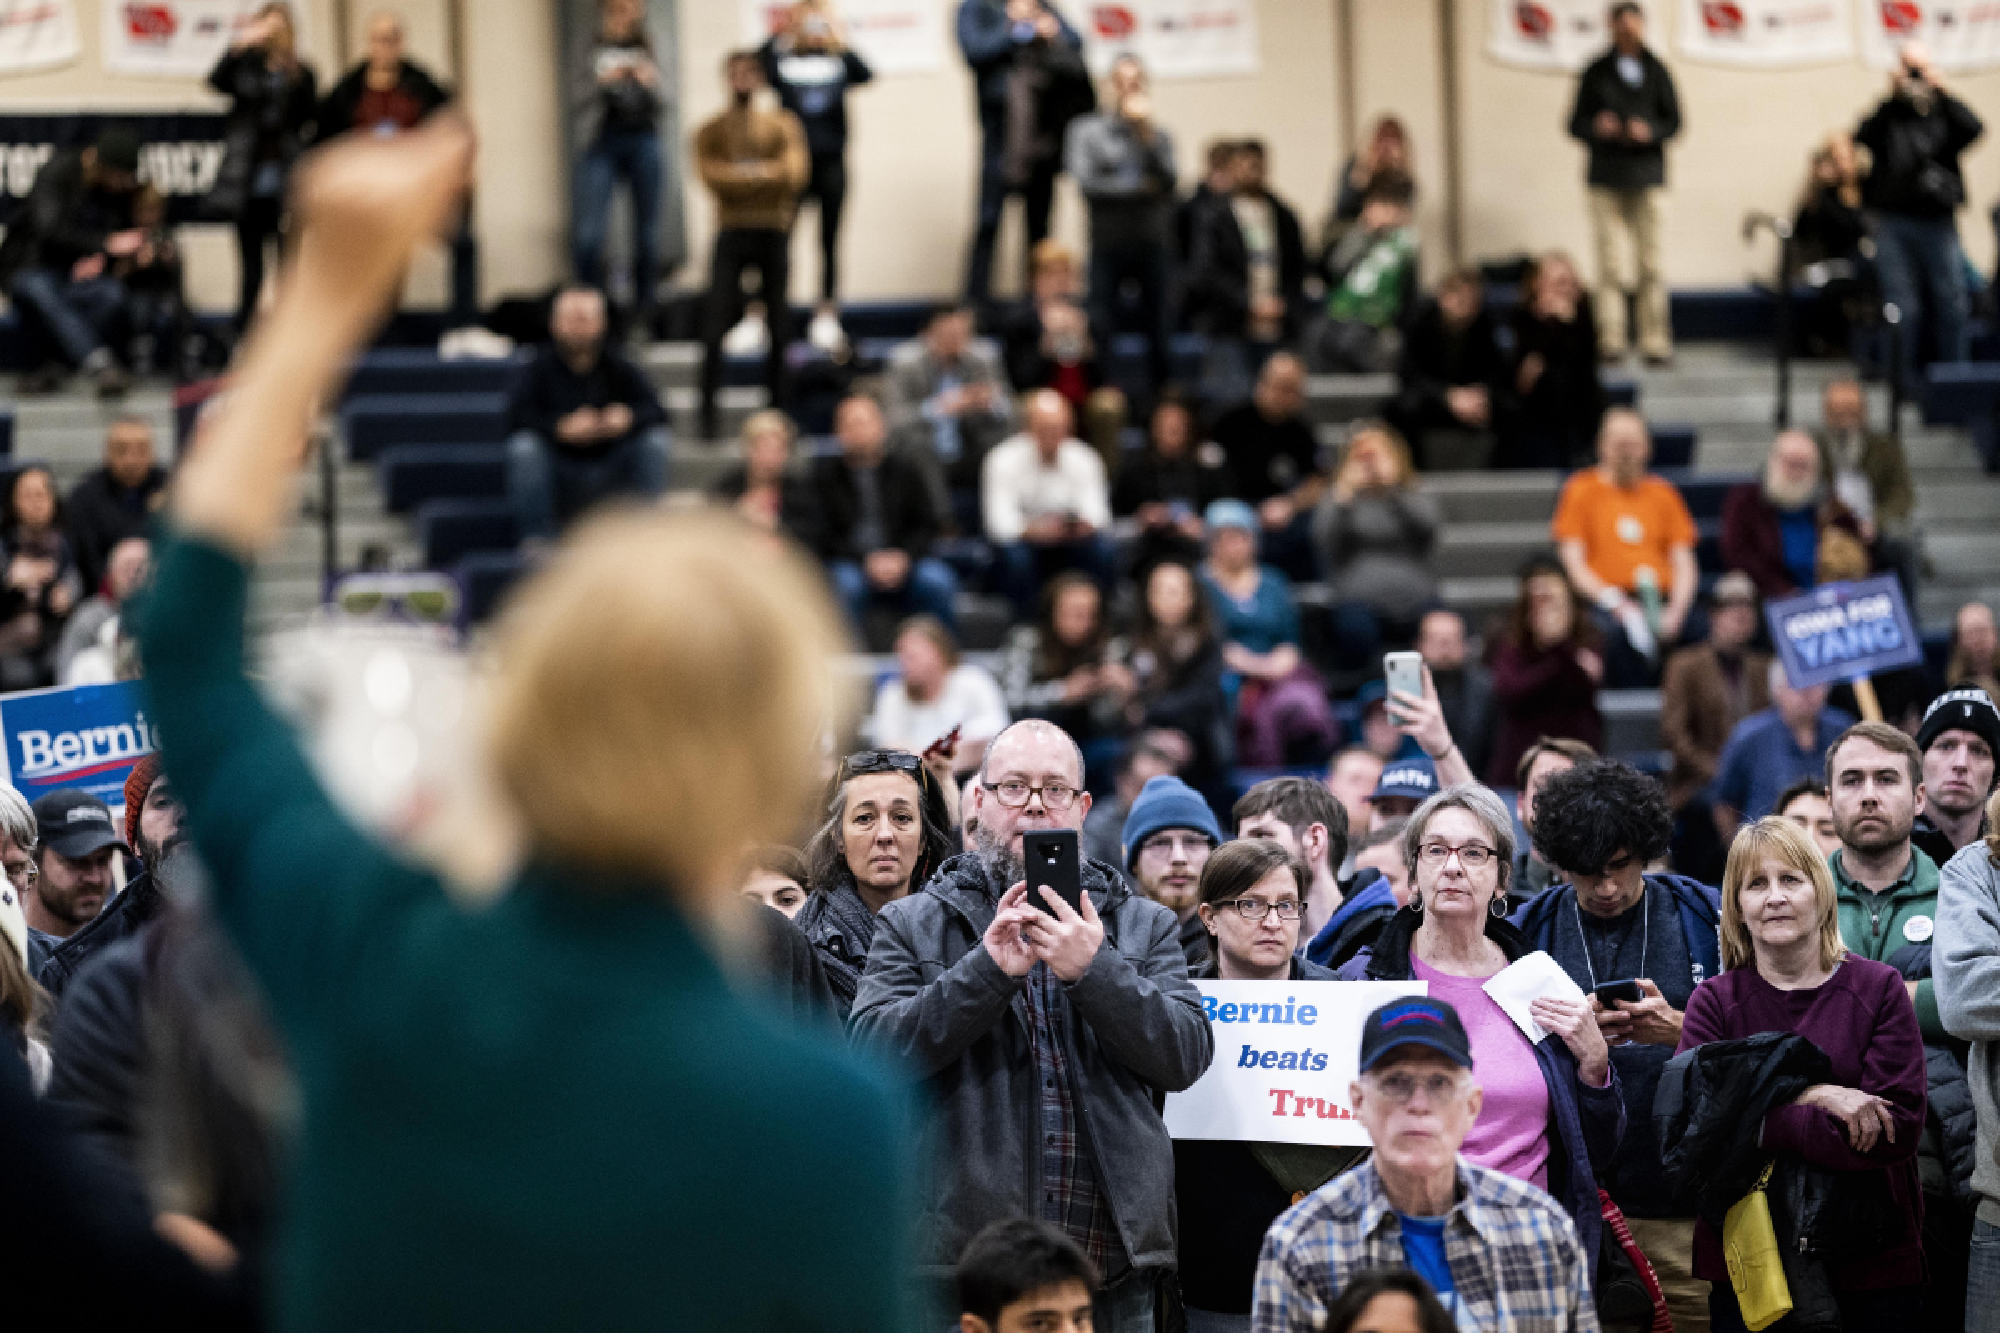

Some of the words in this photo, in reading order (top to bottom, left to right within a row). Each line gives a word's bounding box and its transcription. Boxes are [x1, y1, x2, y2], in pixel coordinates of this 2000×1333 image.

[1202, 996, 1318, 1025] Bernie
[1237, 1044, 1329, 1071] beats
[1268, 1087, 1358, 1120] Tru
